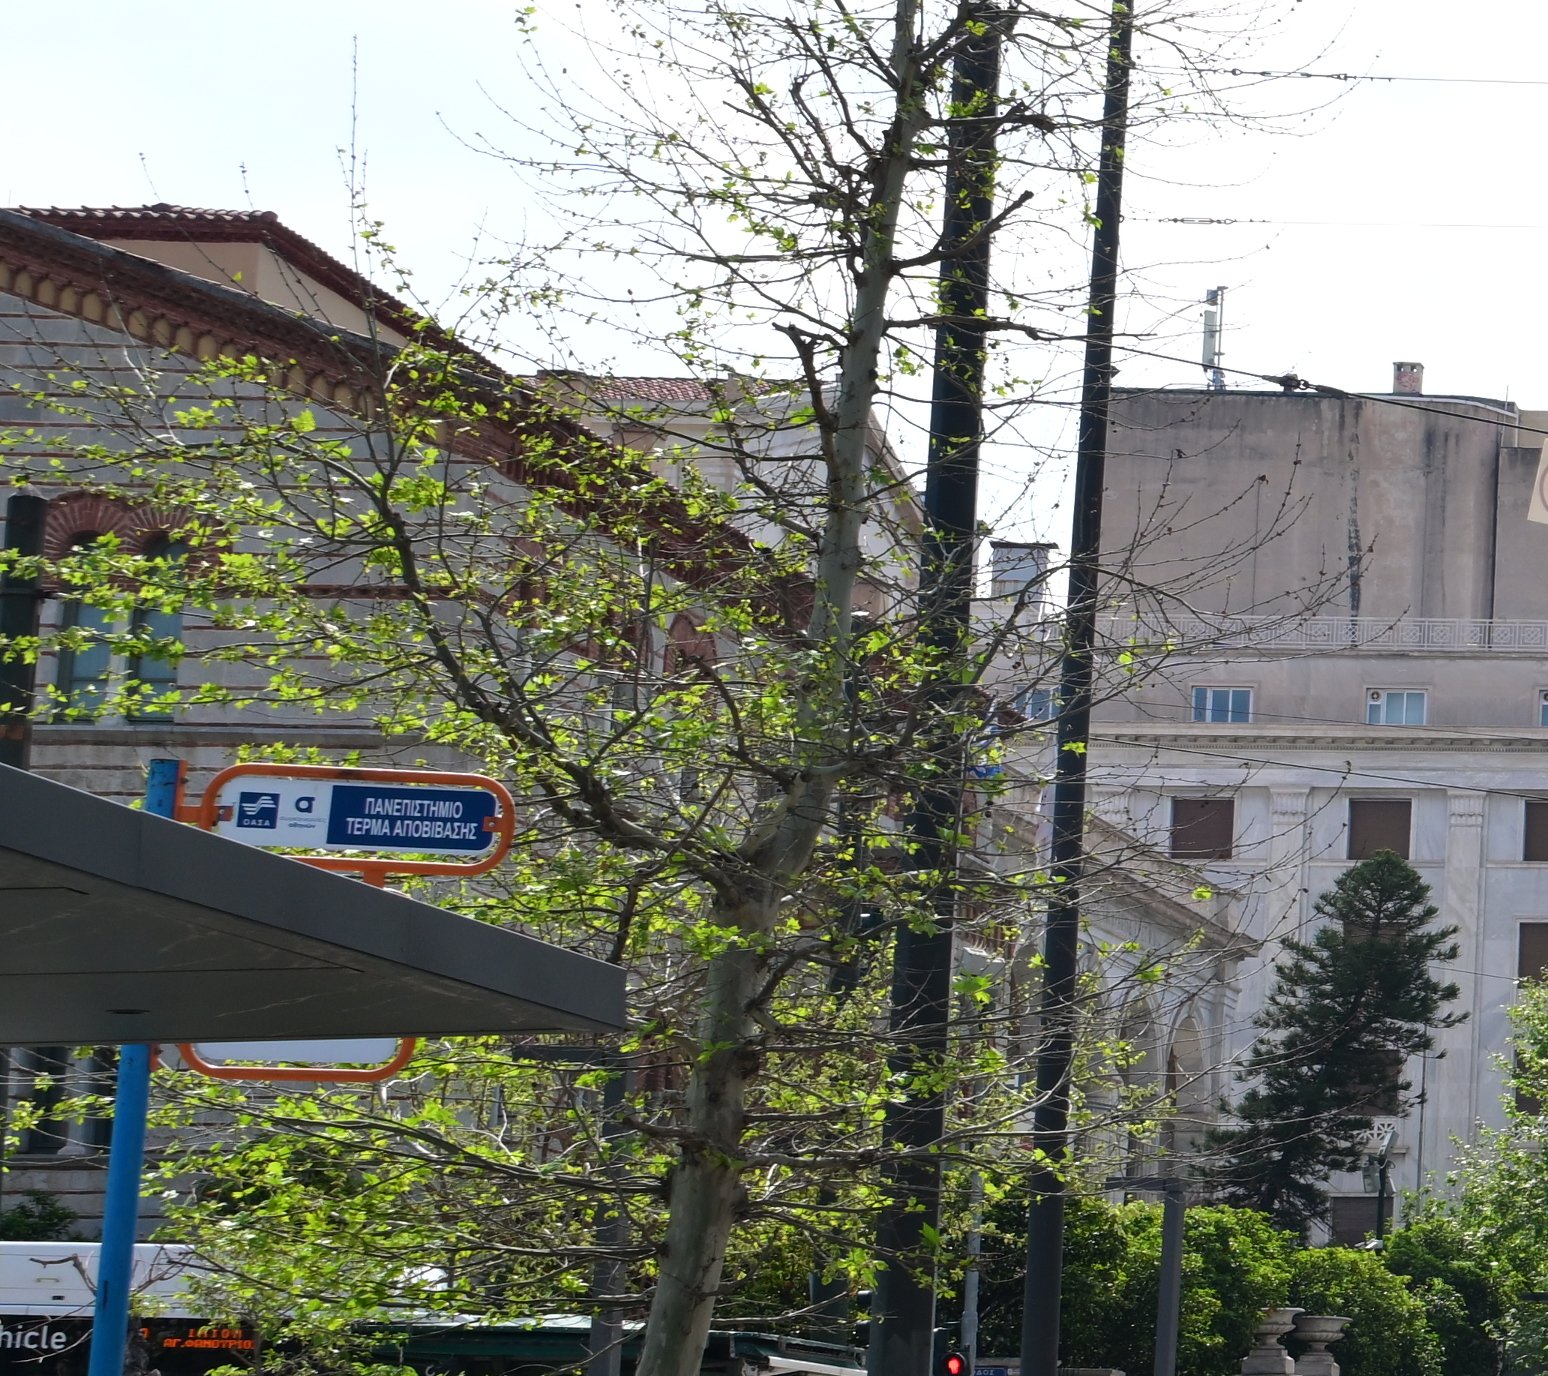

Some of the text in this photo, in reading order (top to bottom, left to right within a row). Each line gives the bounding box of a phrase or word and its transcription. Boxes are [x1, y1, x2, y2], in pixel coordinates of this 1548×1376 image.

[365, 798, 463, 819] ΠΑΝΕΠΙΣΤΗΜΙΟ
[243, 818, 271, 827] ΟΑΣΑ
[346, 817, 478, 840] ΤΕΡΜΑ ΑΠΟΒΙΒΑΣΗΣ
